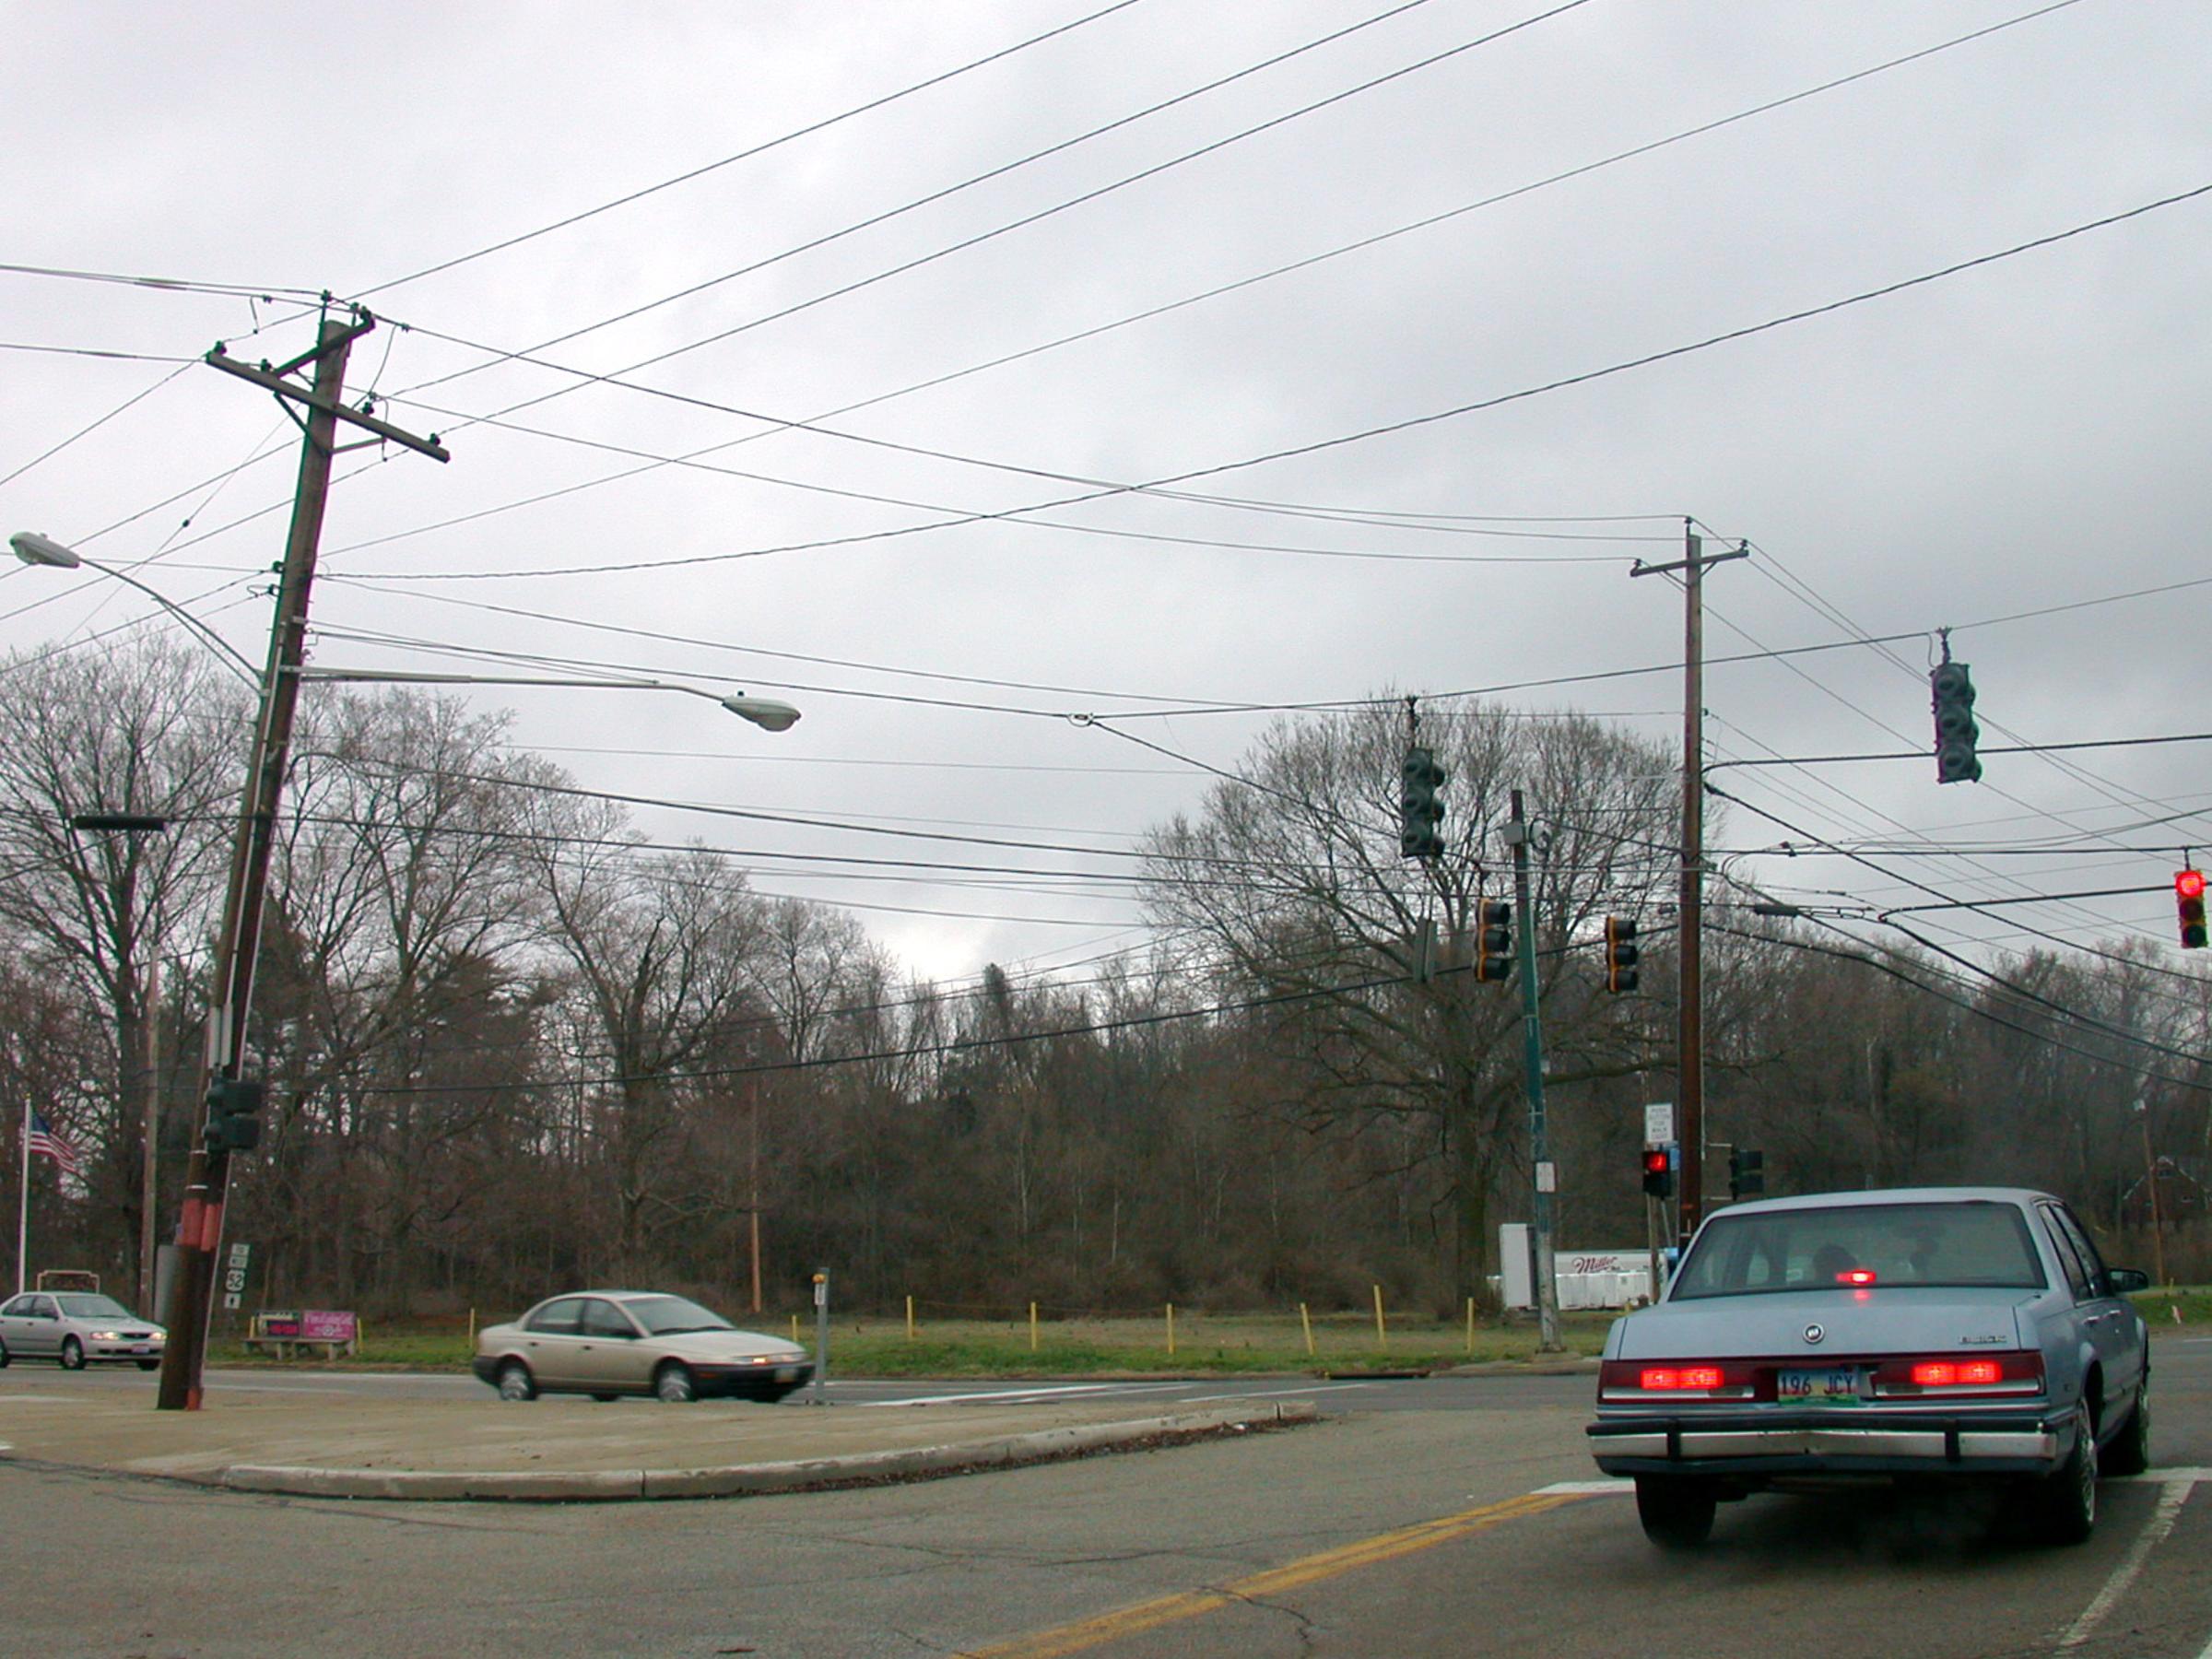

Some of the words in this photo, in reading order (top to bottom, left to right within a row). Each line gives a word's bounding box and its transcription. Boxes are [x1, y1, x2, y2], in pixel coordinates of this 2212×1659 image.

[1572, 1256, 1618, 1274] Miller
[229, 1273, 242, 1288] 52
[1782, 1375, 1812, 1395] 196
[1823, 1374, 1853, 1395] JCY
